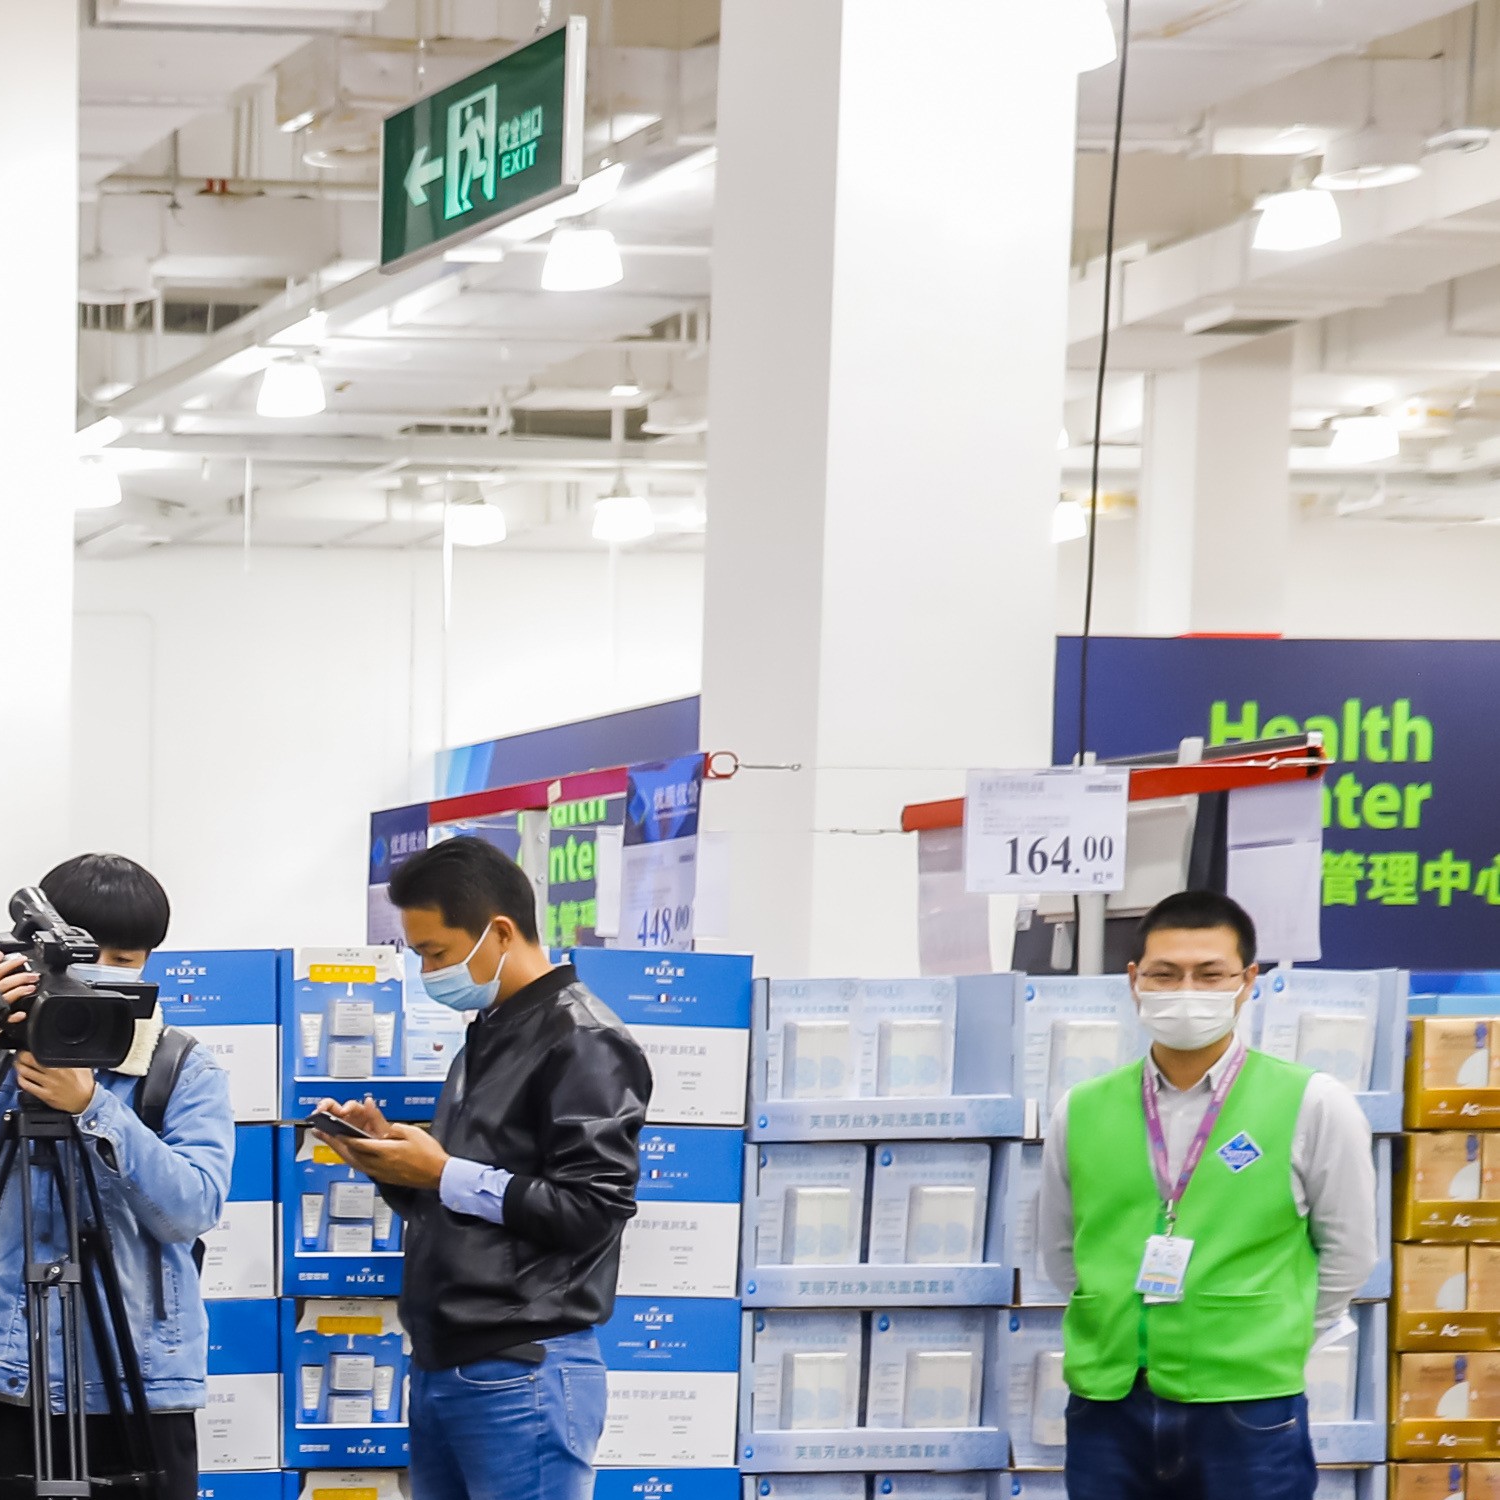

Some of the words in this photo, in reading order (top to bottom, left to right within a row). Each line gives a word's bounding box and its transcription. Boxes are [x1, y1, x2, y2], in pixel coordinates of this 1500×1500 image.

[501, 141, 537, 180] EXIT
[1005, 835, 1114, 876] 164.00
[638, 904, 689, 948] 448.00
[165, 966, 208, 977] NUXE
[644, 967, 685, 977] NUXE
[346, 1274, 385, 1283] NUXE
[633, 1314, 674, 1323] NUXE
[347, 1445, 386, 1454] NUXE
[632, 1483, 673, 1493] NUXE
